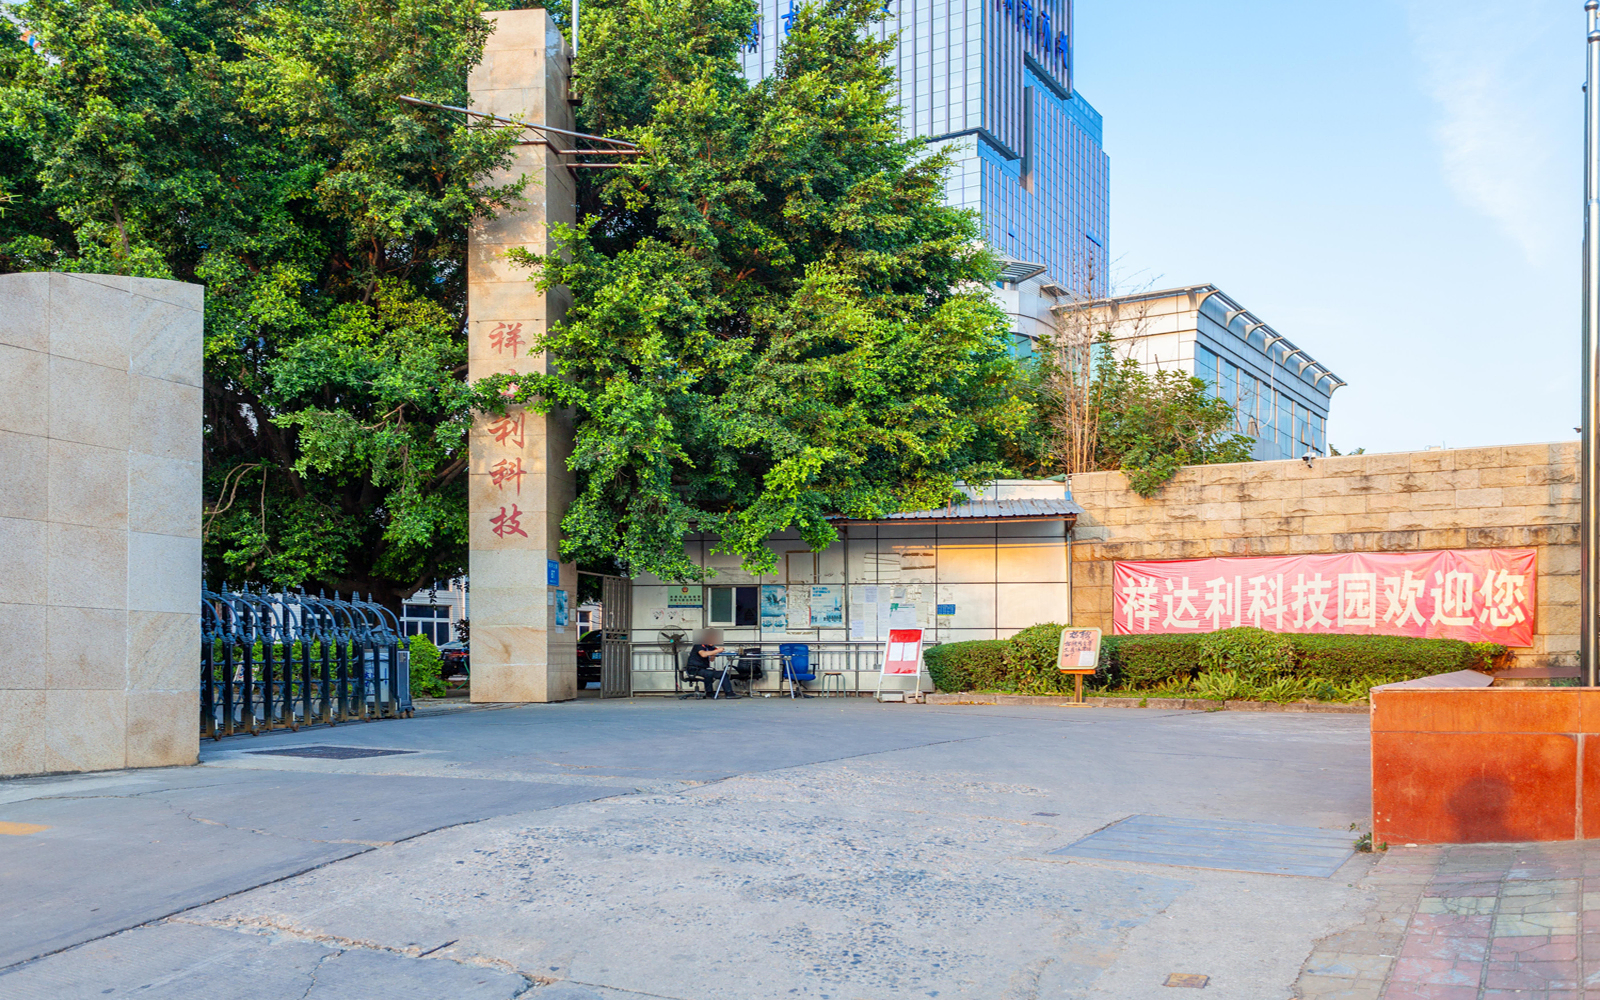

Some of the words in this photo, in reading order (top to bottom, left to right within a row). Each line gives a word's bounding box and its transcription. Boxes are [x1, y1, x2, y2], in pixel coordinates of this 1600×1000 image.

[1122, 570, 1526, 630] 祥达利科技园欢迎您
